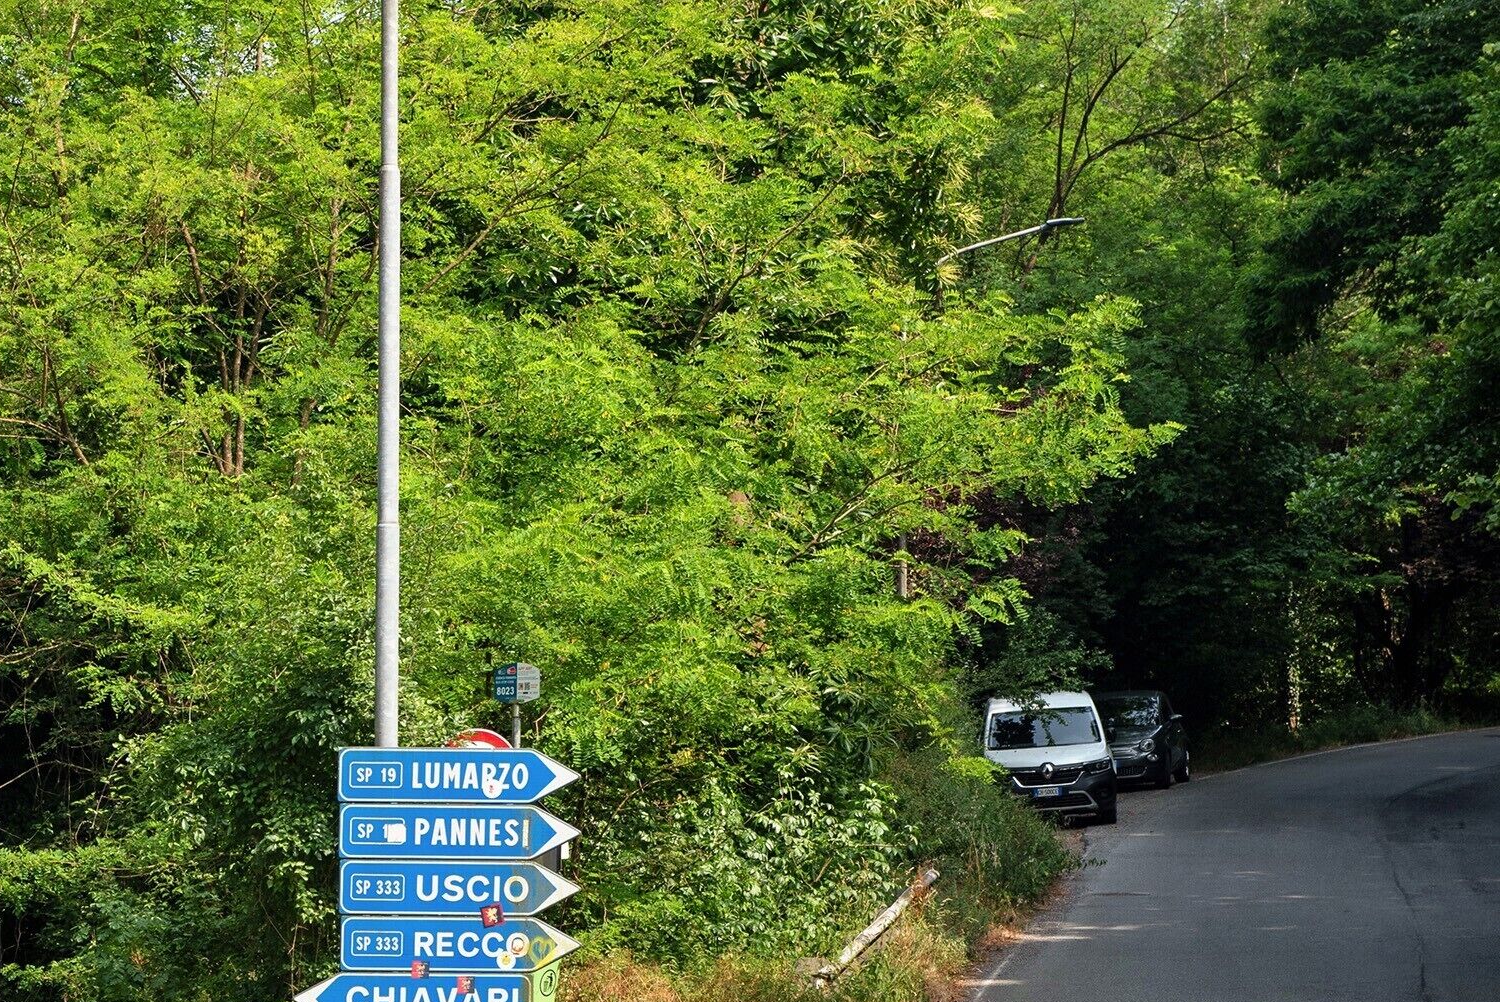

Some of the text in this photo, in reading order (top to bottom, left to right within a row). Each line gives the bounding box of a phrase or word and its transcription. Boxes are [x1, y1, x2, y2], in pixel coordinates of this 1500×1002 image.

[356, 761, 530, 790] SP 19 LUMARZO
[357, 823, 374, 839] SP
[414, 817, 530, 848] PANNESI
[355, 874, 530, 903] SP 333 USCIO
[355, 931, 530, 958] SP 333 RECCO
